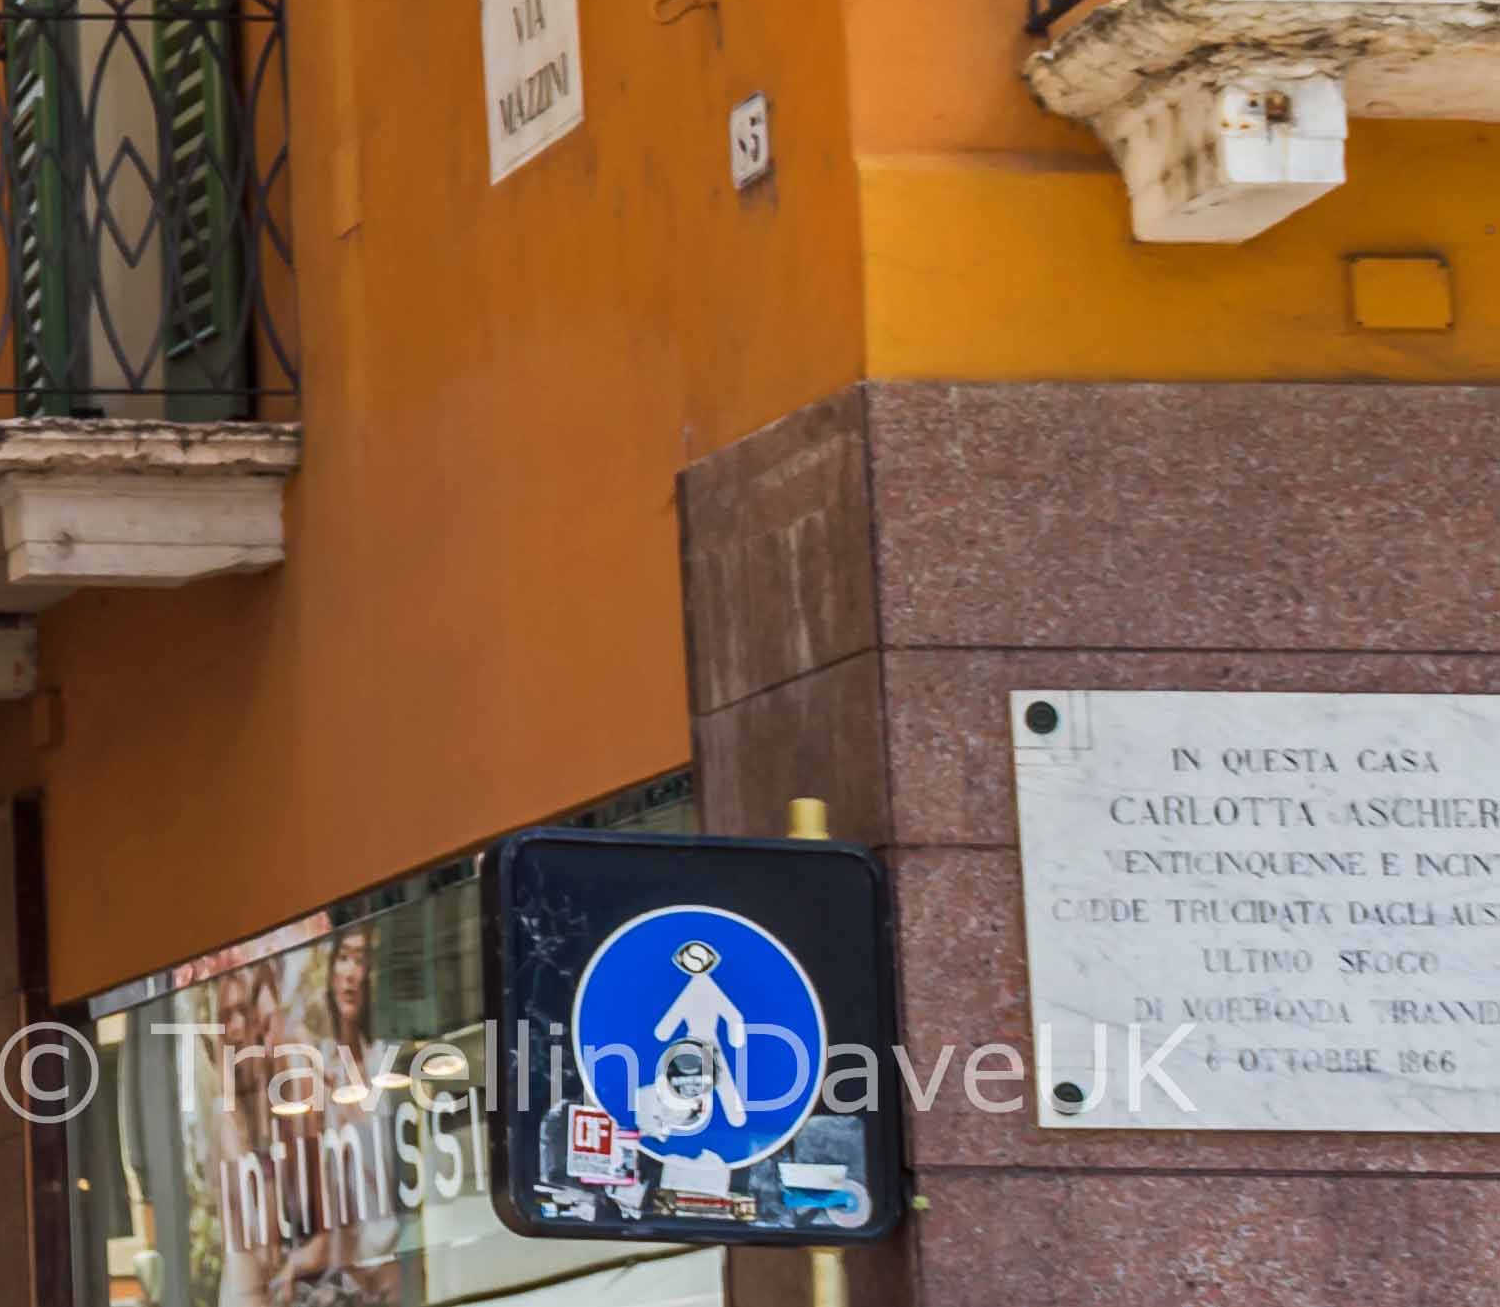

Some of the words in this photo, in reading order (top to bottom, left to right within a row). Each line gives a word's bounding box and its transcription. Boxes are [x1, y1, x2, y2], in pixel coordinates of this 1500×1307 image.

[499, 51, 570, 136] MAZZINI
[1170, 747, 1201, 772] IN
[1222, 747, 1339, 776] QUESTA
[1357, 748, 1441, 774] CASA
[1108, 794, 1316, 827] CARLOTTA
[1104, 849, 1367, 879] VENTICINQUENNE
[1380, 852, 1401, 877] E
[1165, 898, 1334, 926] TRUCIDATA
[1202, 947, 1314, 974] ULTIMO
[1238, 1047, 1381, 1074] OTTOBRE
[1398, 1049, 1457, 1074] 1866
